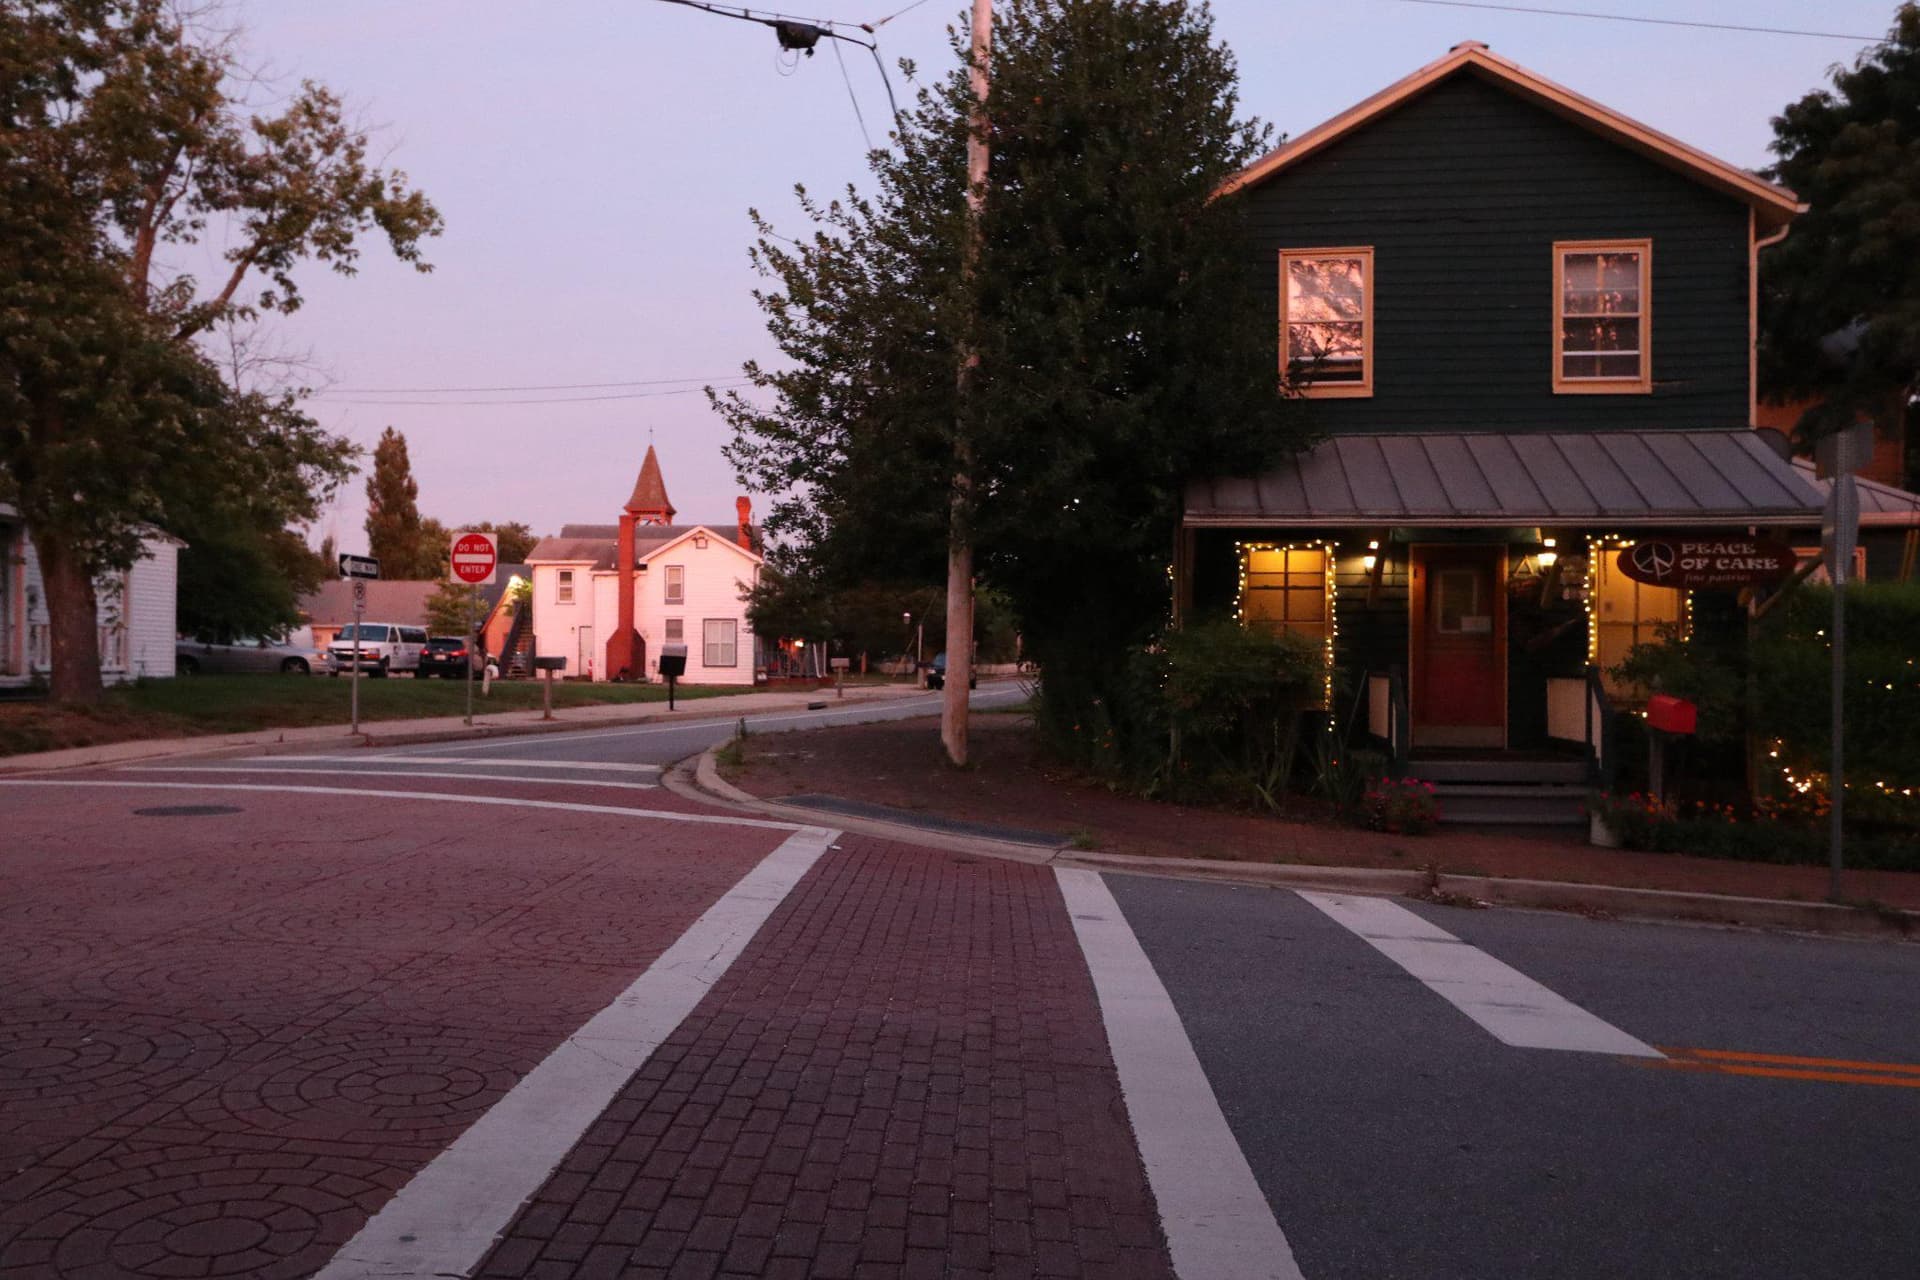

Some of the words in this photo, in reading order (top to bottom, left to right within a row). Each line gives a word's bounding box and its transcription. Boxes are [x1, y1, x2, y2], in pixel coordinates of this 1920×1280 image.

[458, 543, 470, 552] DO
[473, 543, 490, 552] NOT
[1681, 543, 1757, 555] PEACE
[1680, 557, 1710, 570] OF
[1715, 557, 1780, 570] CAKE
[460, 565, 486, 574] ENTER
